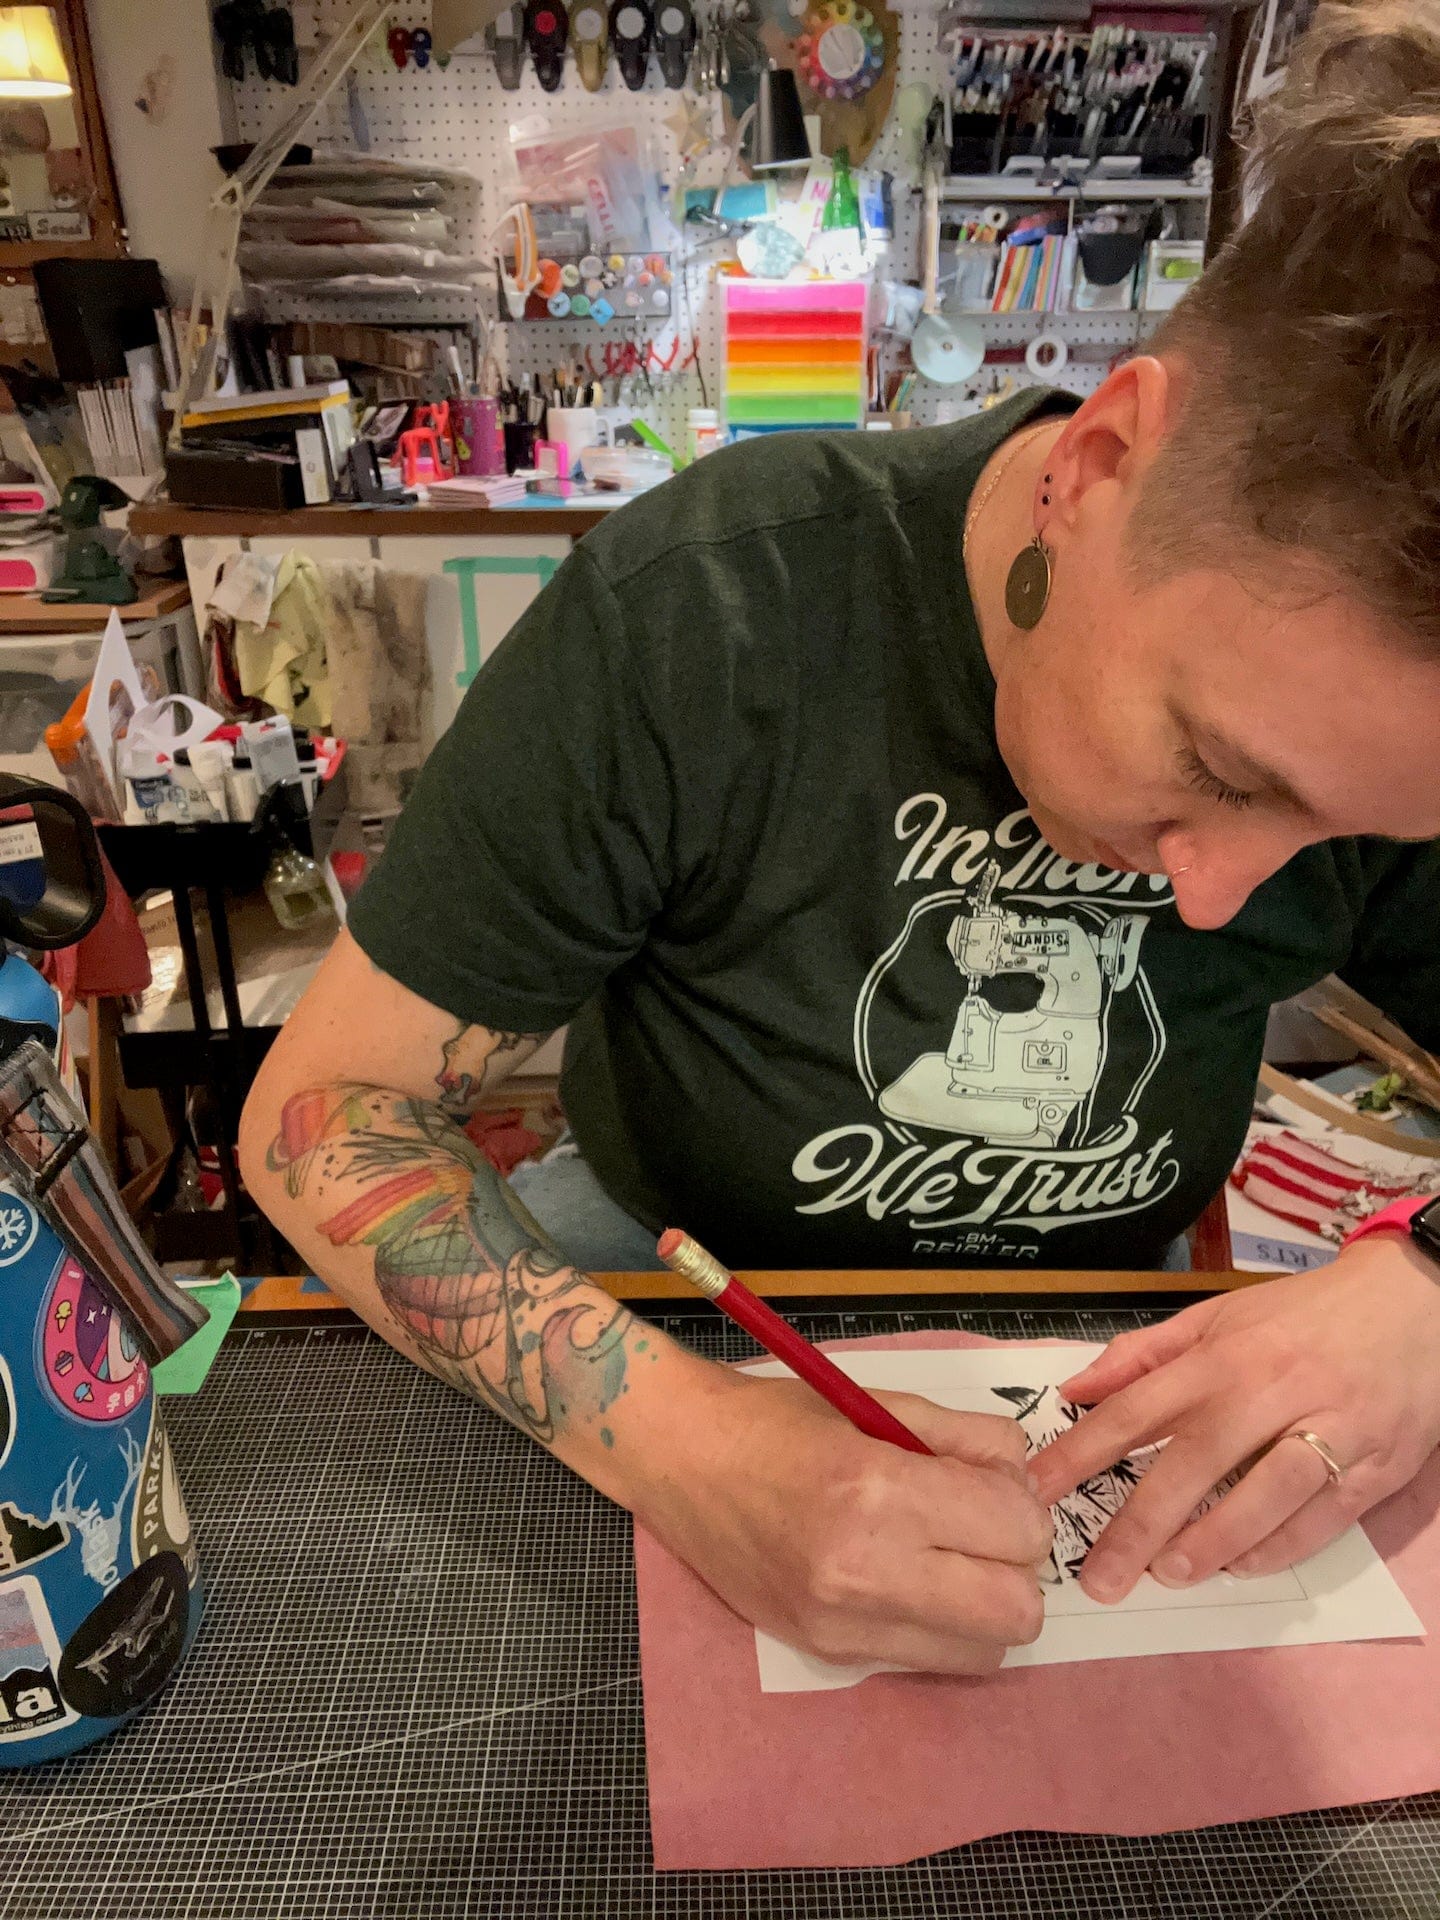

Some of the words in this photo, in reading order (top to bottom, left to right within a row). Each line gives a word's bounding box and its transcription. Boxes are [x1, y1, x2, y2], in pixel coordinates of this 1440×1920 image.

[894, 793, 989, 887] In
[792, 1124, 973, 1221] We
[962, 1114, 1180, 1232] Trust
[143, 1428, 164, 1540] PARKS
